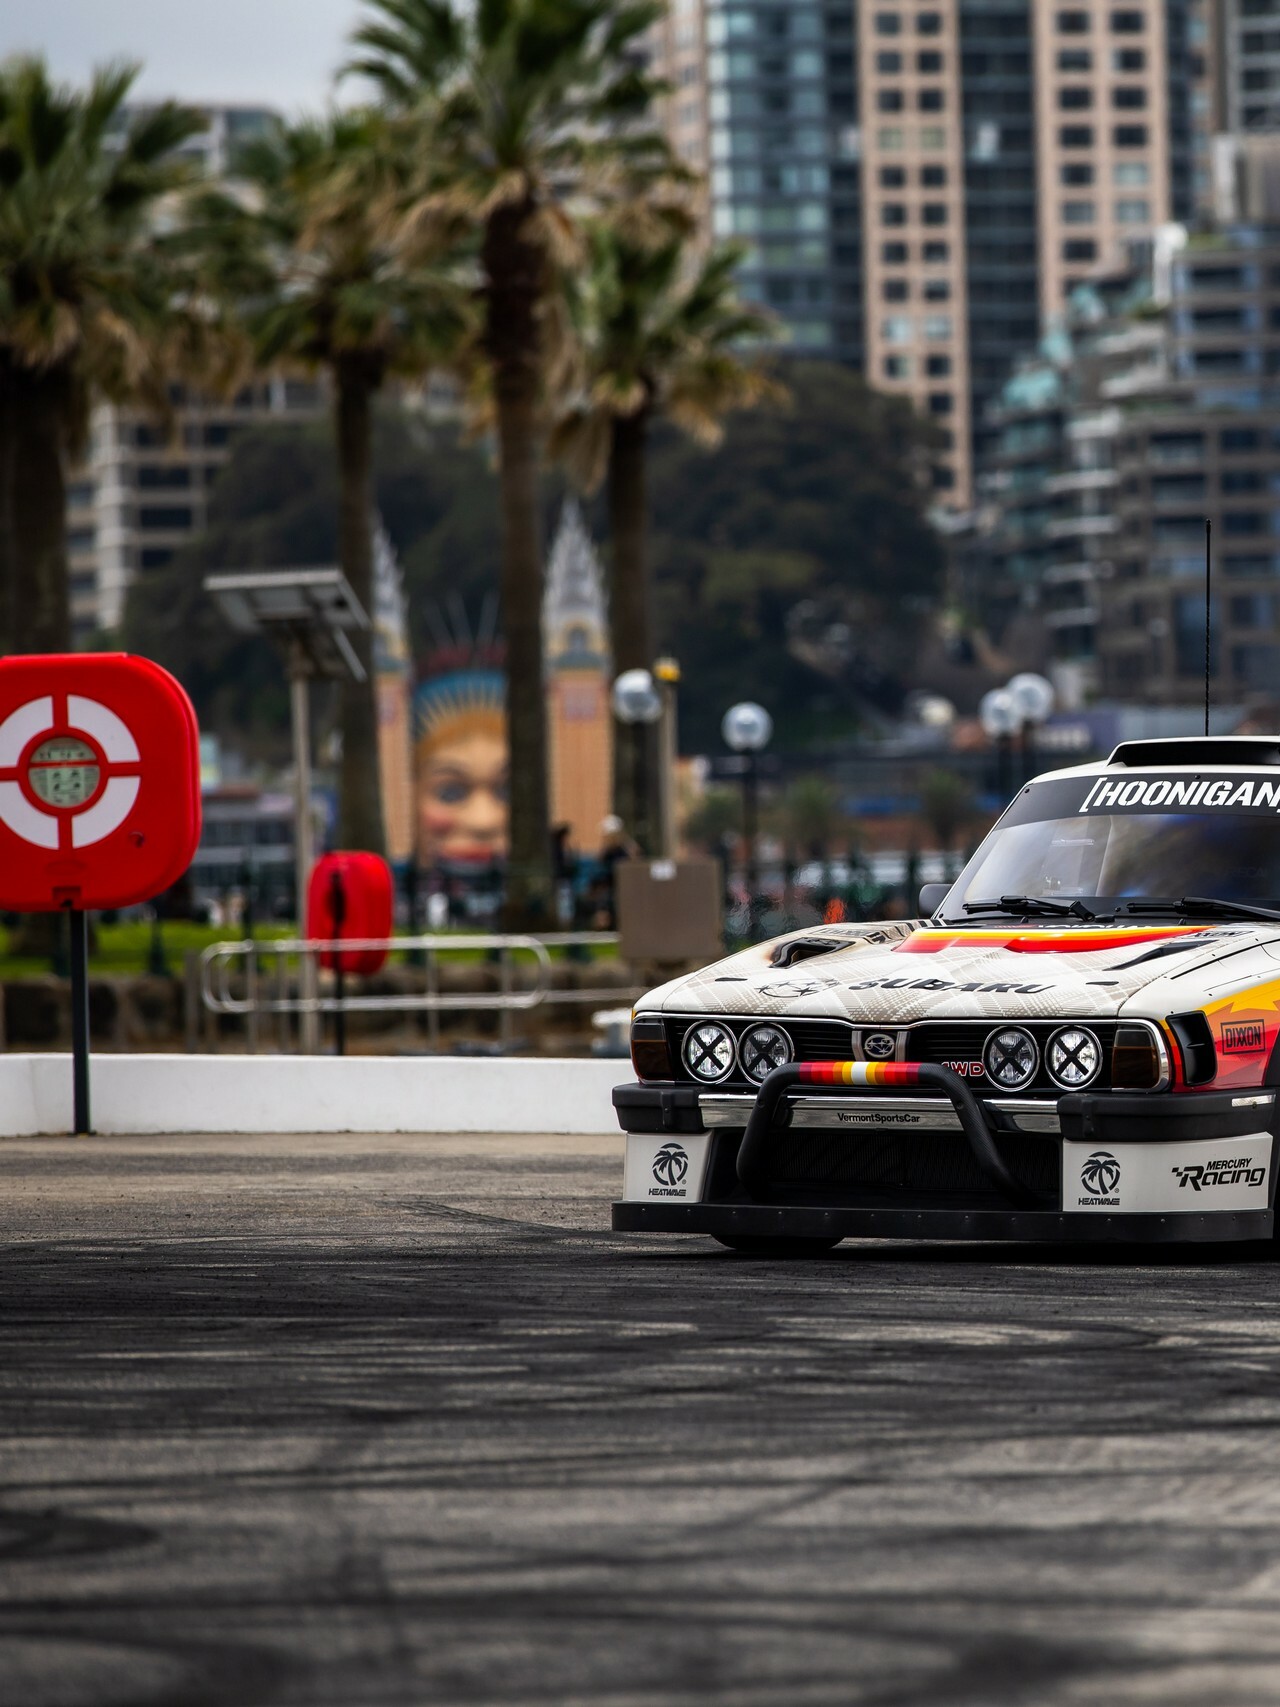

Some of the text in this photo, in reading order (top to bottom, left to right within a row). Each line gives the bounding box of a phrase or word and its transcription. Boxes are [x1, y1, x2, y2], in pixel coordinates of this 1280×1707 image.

[849, 978, 1056, 994] SUBARU
[837, 1113, 920, 1124] VermontSportsCar
[1206, 1158, 1252, 1171] MERCURY
[1178, 1166, 1266, 1191] Racing
[648, 1188, 687, 1197] HEATWAVE
[1078, 1197, 1121, 1206] HEATWAVE
